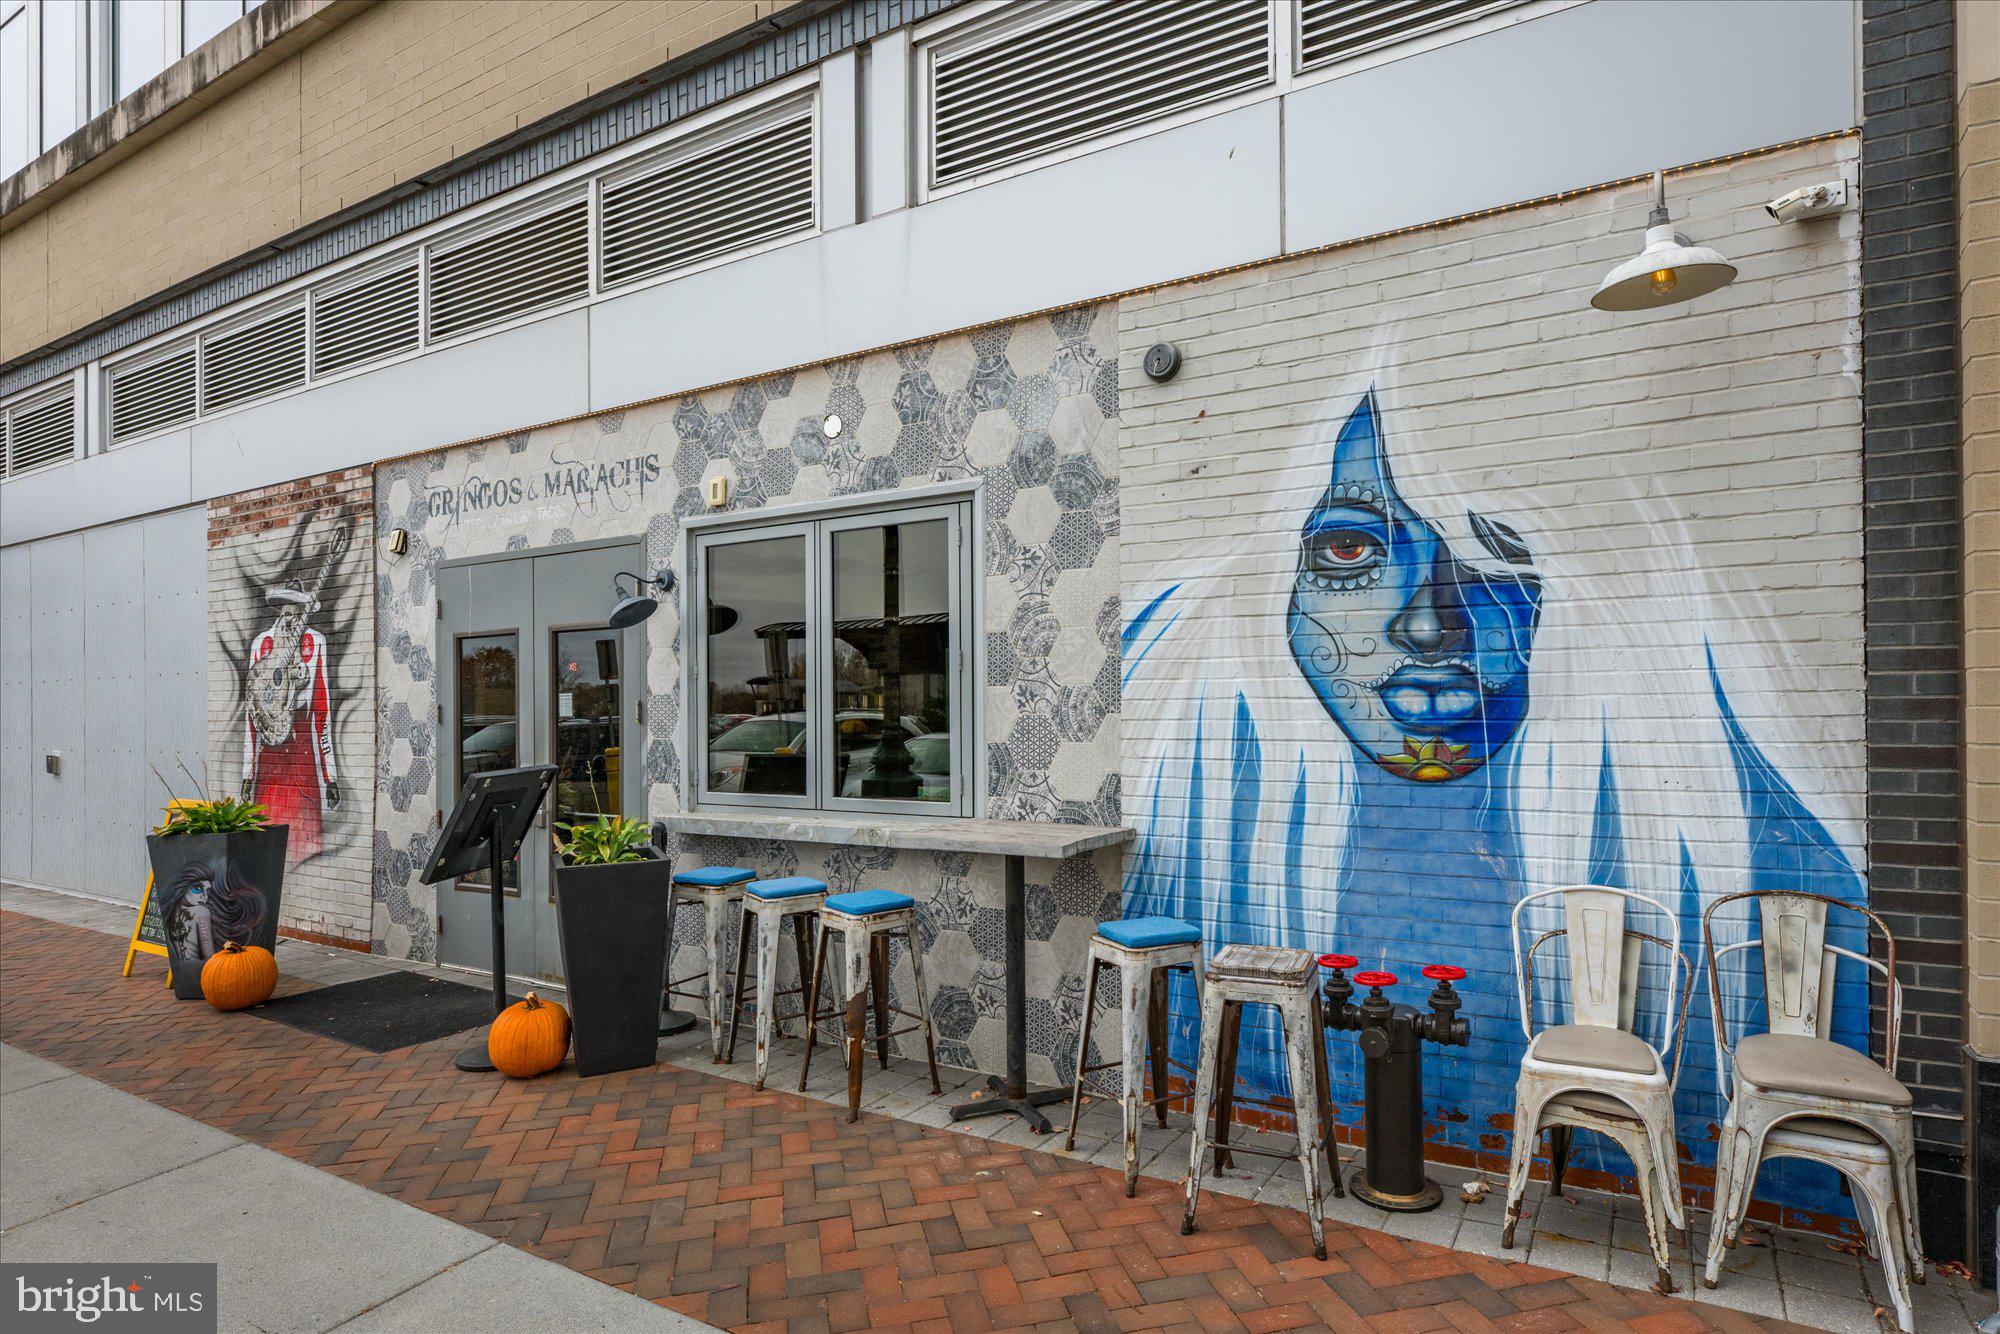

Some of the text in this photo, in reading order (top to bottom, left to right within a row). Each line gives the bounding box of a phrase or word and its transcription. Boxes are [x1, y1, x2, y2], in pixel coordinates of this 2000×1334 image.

[426, 450, 660, 531] GRINGOS & MARIACHIS
